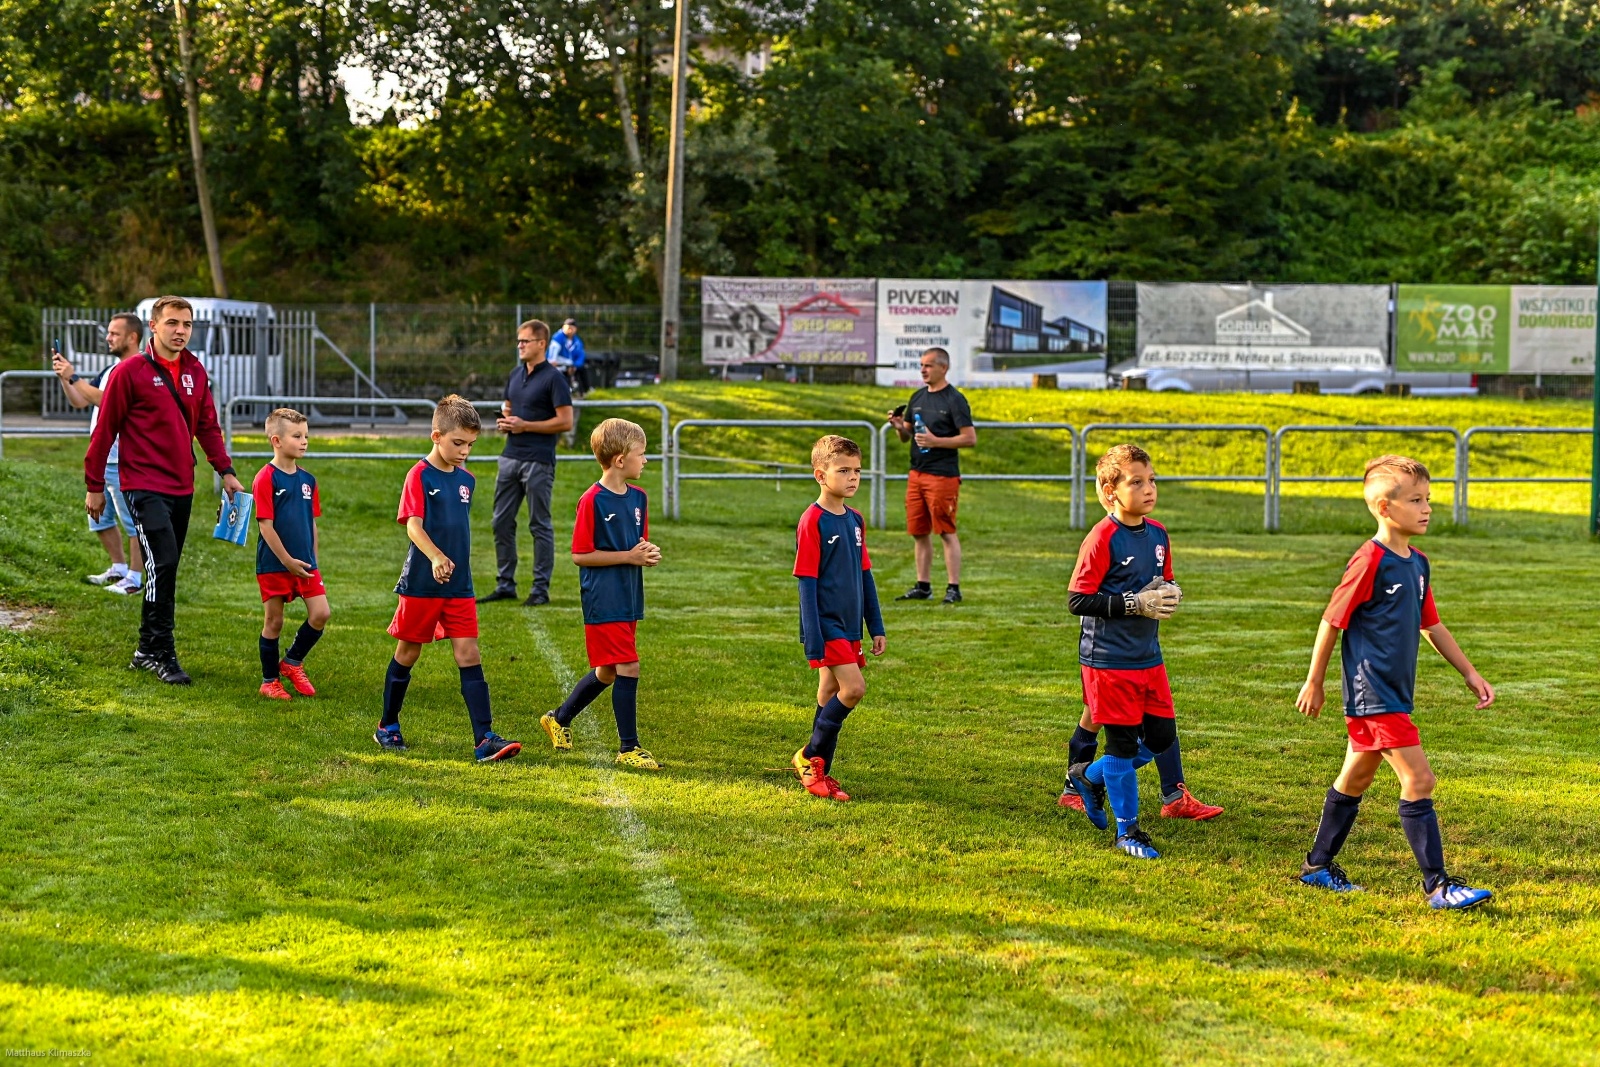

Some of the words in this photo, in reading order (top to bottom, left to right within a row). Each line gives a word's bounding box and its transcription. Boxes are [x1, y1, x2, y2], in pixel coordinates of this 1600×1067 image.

[887, 290, 959, 304] PIVEXIN
[888, 306, 958, 315] TECHNOLOGY
[1519, 298, 1584, 312] WSZYSTKO
[1441, 304, 1497, 322] ZOO
[1519, 314, 1594, 328] DOMOWEGO
[1437, 323, 1494, 338] MAR
